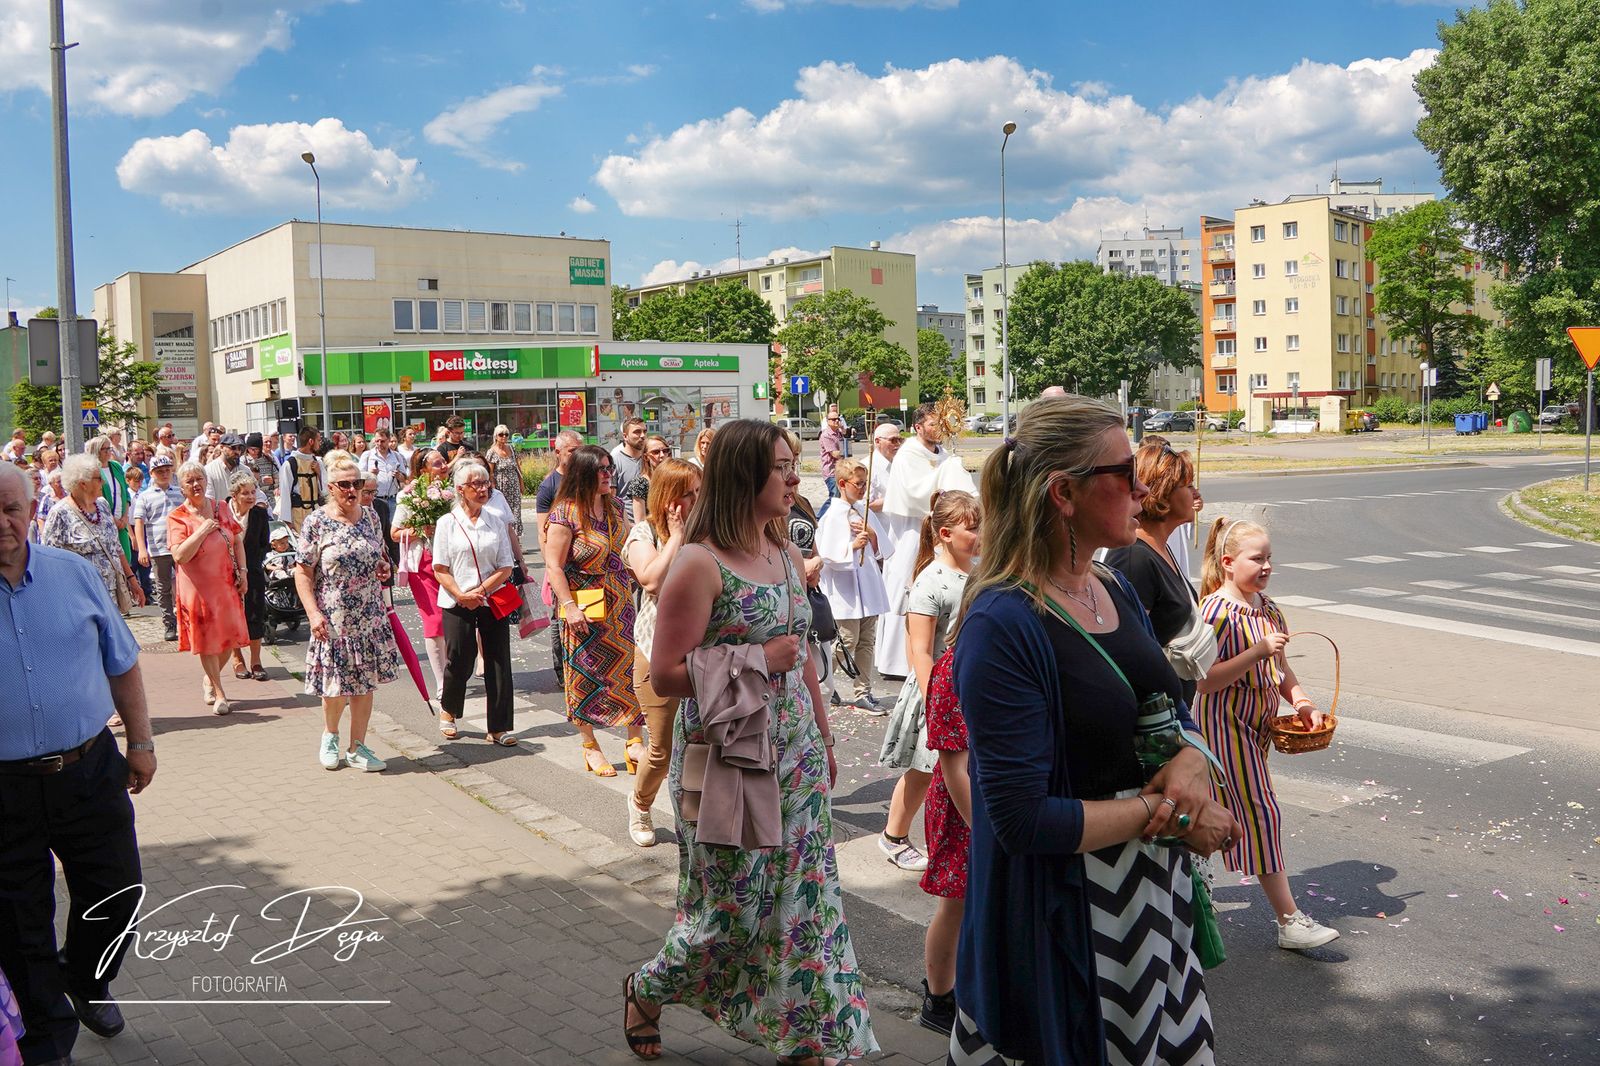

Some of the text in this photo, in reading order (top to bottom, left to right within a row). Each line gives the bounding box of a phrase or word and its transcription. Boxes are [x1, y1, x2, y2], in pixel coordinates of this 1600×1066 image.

[570, 257, 600, 268] GABINET
[230, 349, 247, 361] SALON
[432, 353, 518, 374] Delikatesy
[621, 358, 648, 367] Apteka
[694, 358, 719, 367] Apteka
